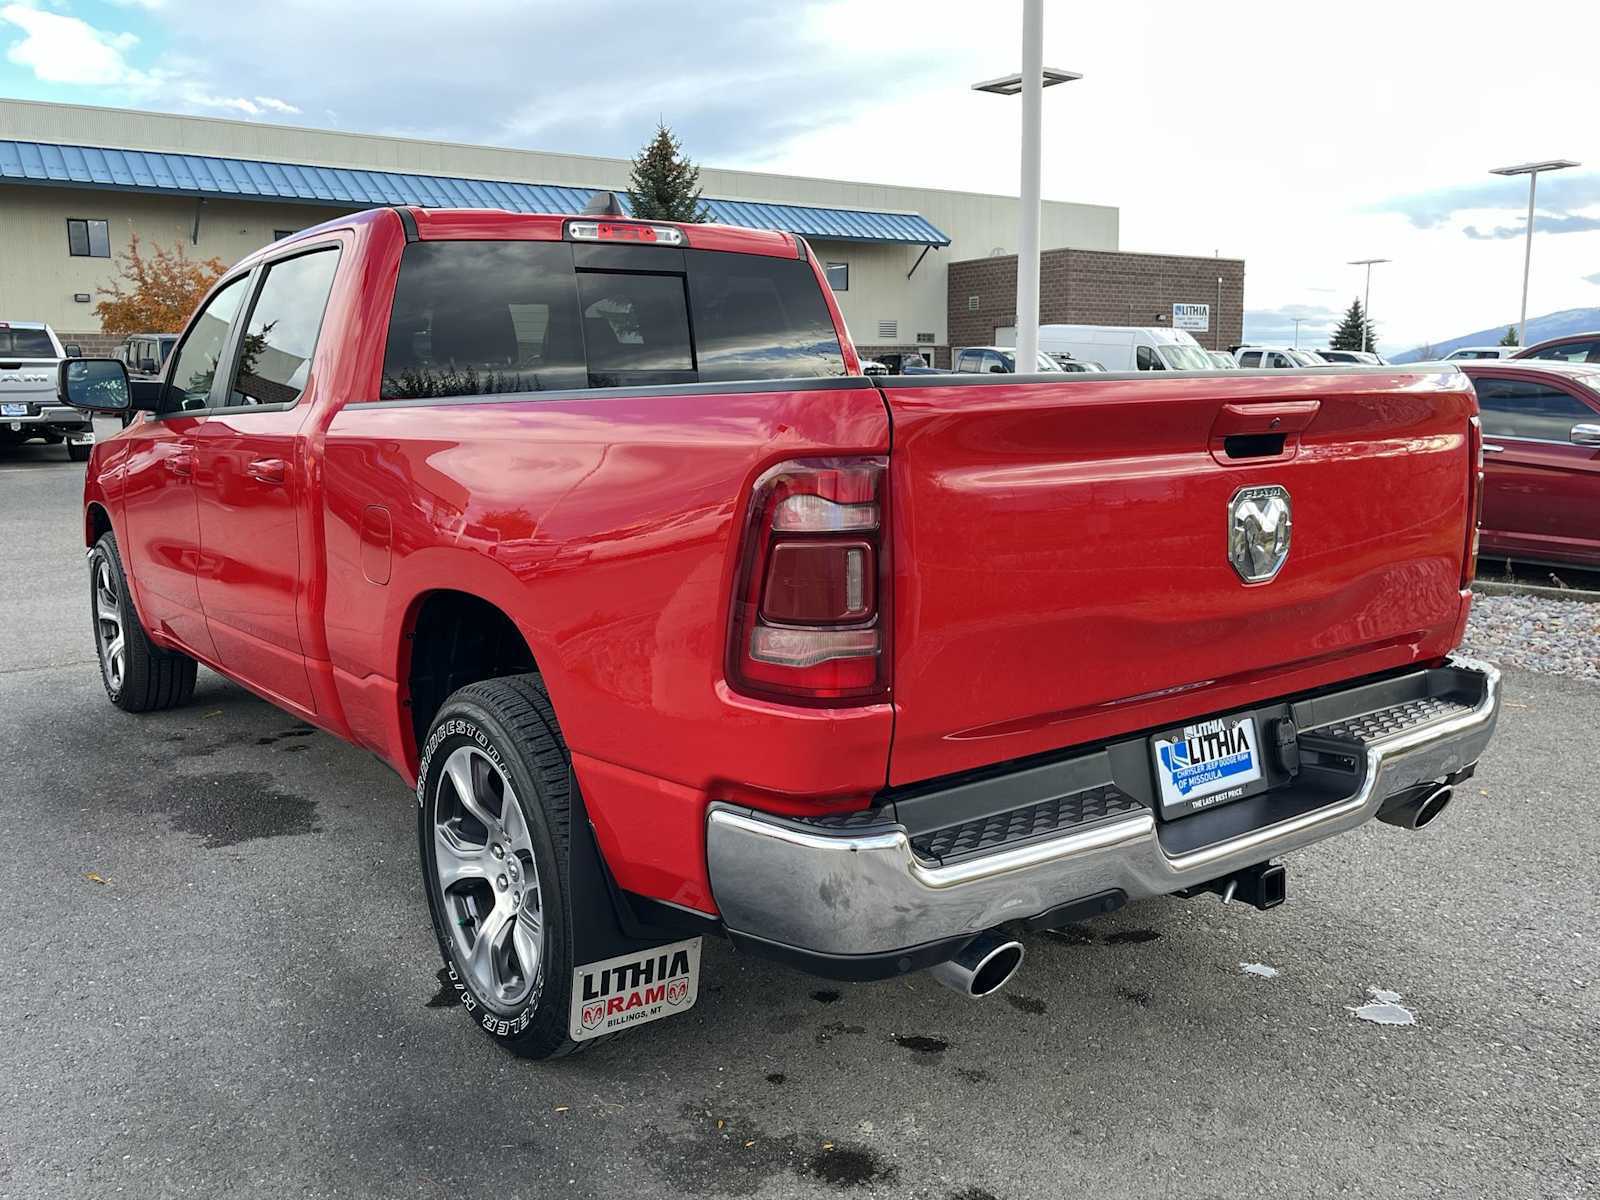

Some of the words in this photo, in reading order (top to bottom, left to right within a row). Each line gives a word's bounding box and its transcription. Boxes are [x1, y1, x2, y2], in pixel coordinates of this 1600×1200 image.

[1182, 305, 1208, 316] LITHIA
[1245, 488, 1281, 498] RAM
[1193, 719, 1226, 738] LITHIA
[1188, 727, 1250, 765] LITHIA
[417, 720, 512, 808] BRIDGESTONE
[1177, 764, 1205, 779] CHRYSLER
[1206, 761, 1218, 771] JEEP
[1219, 756, 1237, 768] DODGE
[1237, 753, 1248, 763] RAM
[1178, 779, 1188, 790] OF
[1189, 769, 1223, 786] MISSOULA
[1192, 800, 1203, 809] THE
[1203, 795, 1215, 807] LAST
[1215, 792, 1228, 803] BEST
[1228, 787, 1243, 799] PRICE
[583, 950, 689, 1001] LITHIA
[607, 984, 665, 1016] RAM
[607, 1009, 648, 1028] BILLINGS,
[650, 1005, 663, 1015] MT
